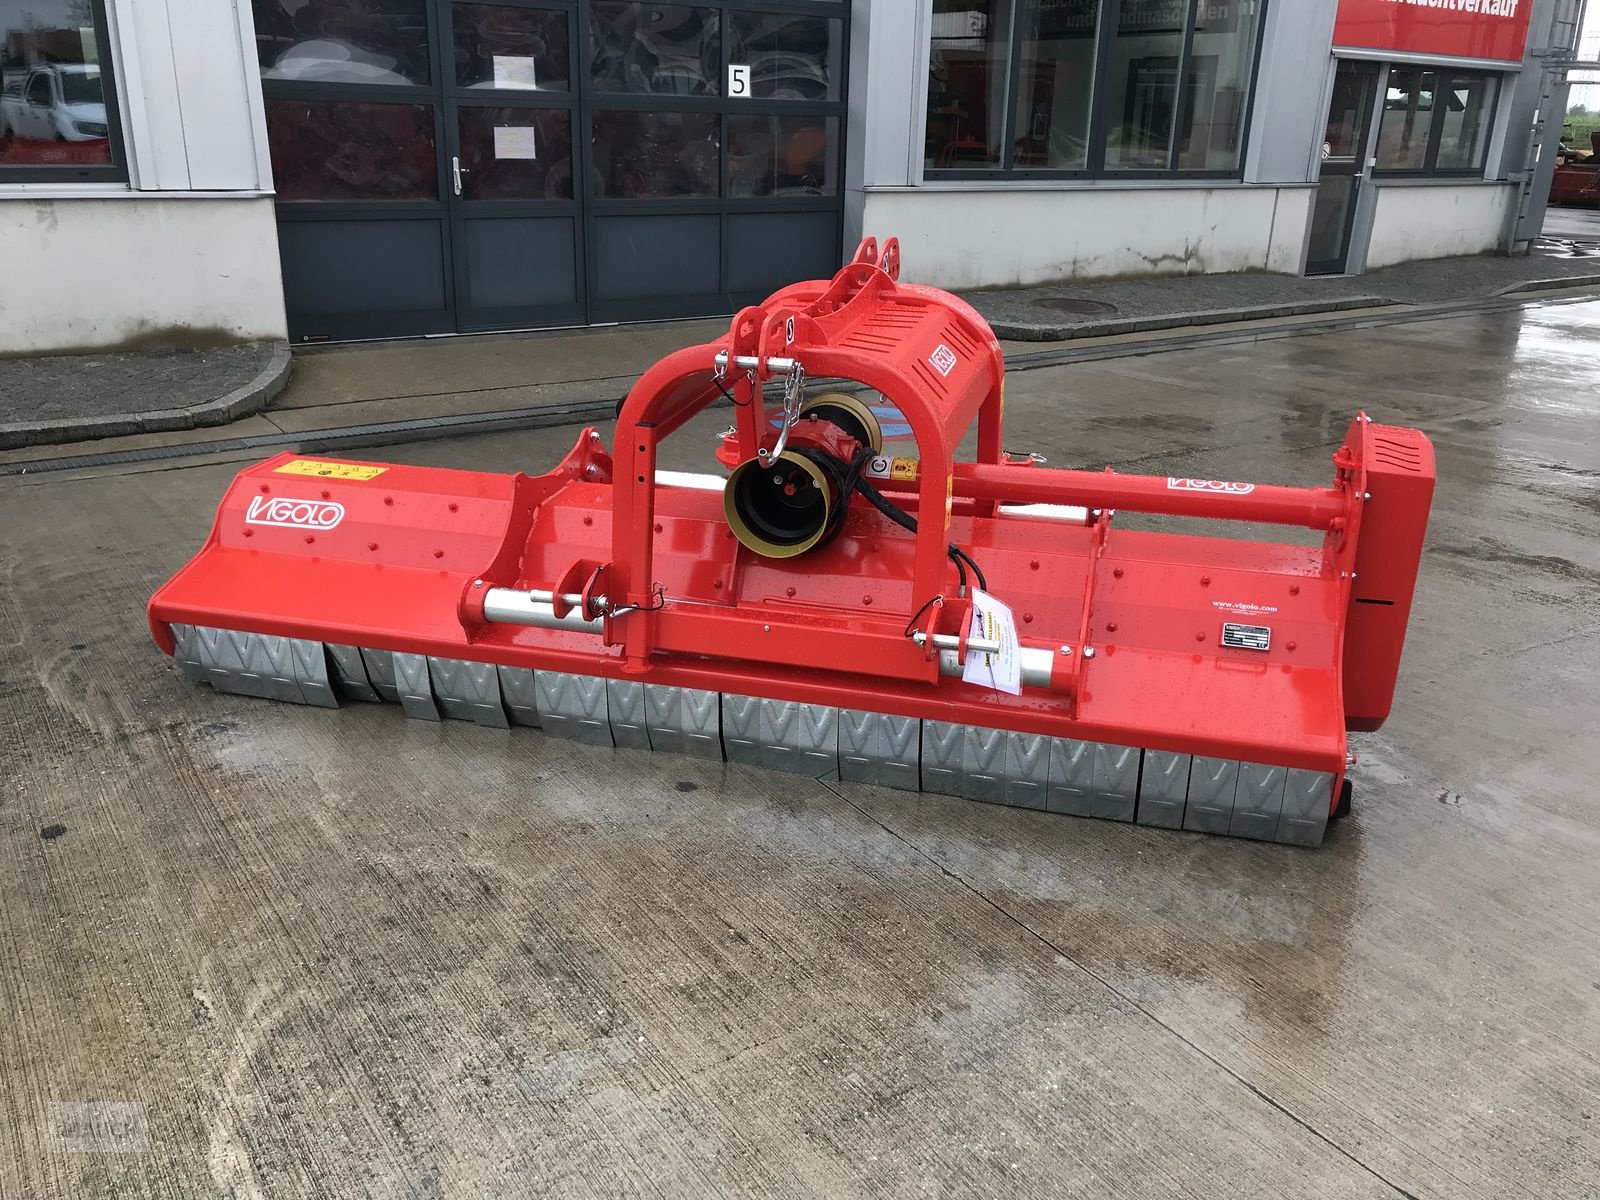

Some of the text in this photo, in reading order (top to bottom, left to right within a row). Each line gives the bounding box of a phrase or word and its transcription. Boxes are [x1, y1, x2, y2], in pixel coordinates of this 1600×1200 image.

[733, 69, 745, 94] 5
[248, 496, 343, 528] VIGOLO
[1212, 601, 1278, 612] www.vigolo.com
